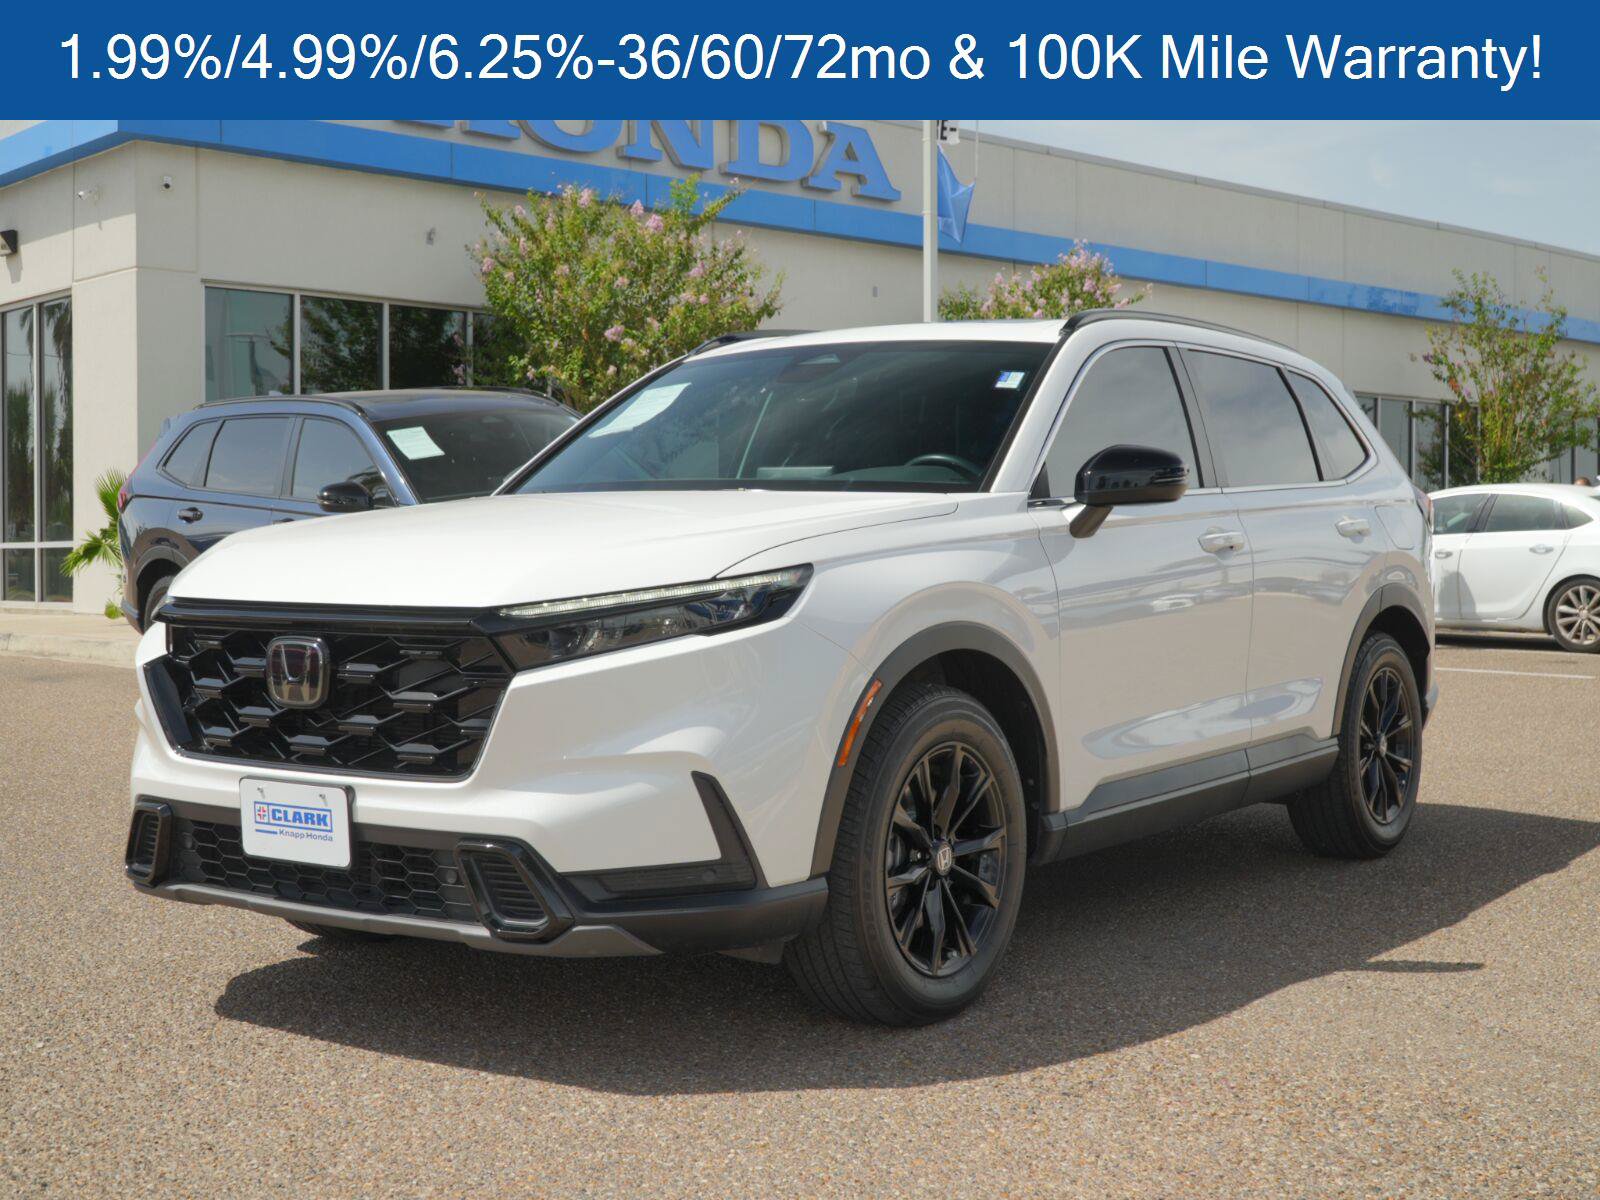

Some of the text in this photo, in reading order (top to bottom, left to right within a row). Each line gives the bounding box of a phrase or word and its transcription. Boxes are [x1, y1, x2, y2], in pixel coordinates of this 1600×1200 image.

[393, 120, 902, 201] NDA
[271, 808, 329, 827] CLARK
[279, 828, 334, 842] Knapp Honda
